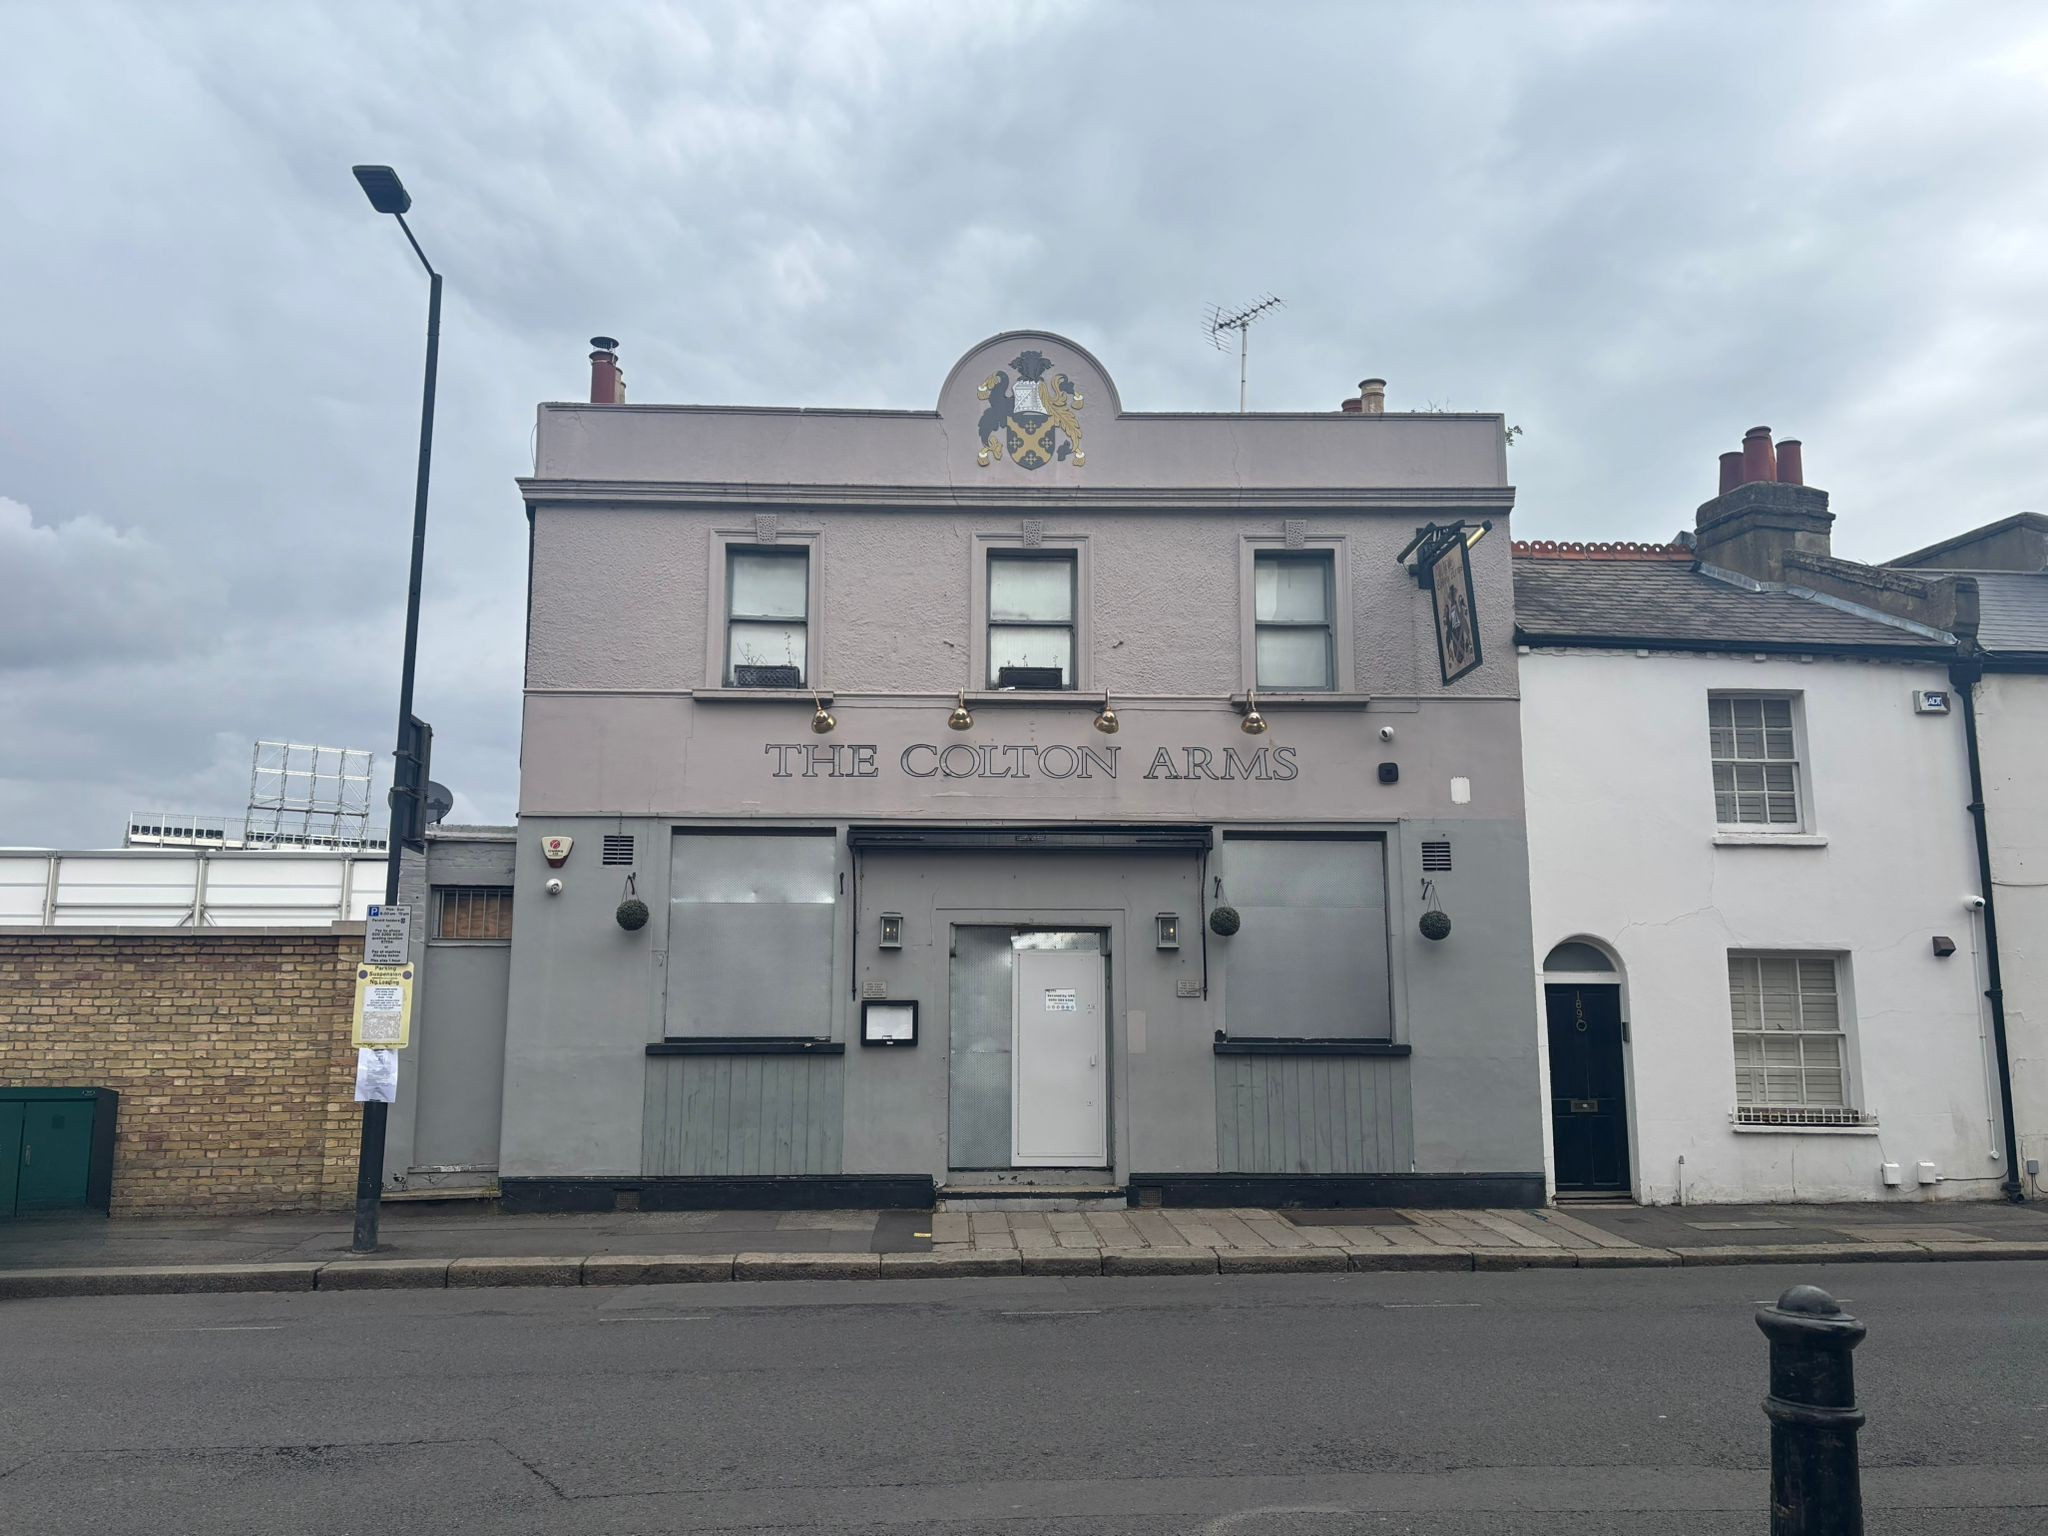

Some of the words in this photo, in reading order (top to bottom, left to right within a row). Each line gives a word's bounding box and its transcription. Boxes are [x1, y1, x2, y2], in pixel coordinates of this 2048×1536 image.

[765, 743, 879, 778] THE
[900, 743, 1121, 779] COLTON
[1143, 746, 1299, 781] ARMS
